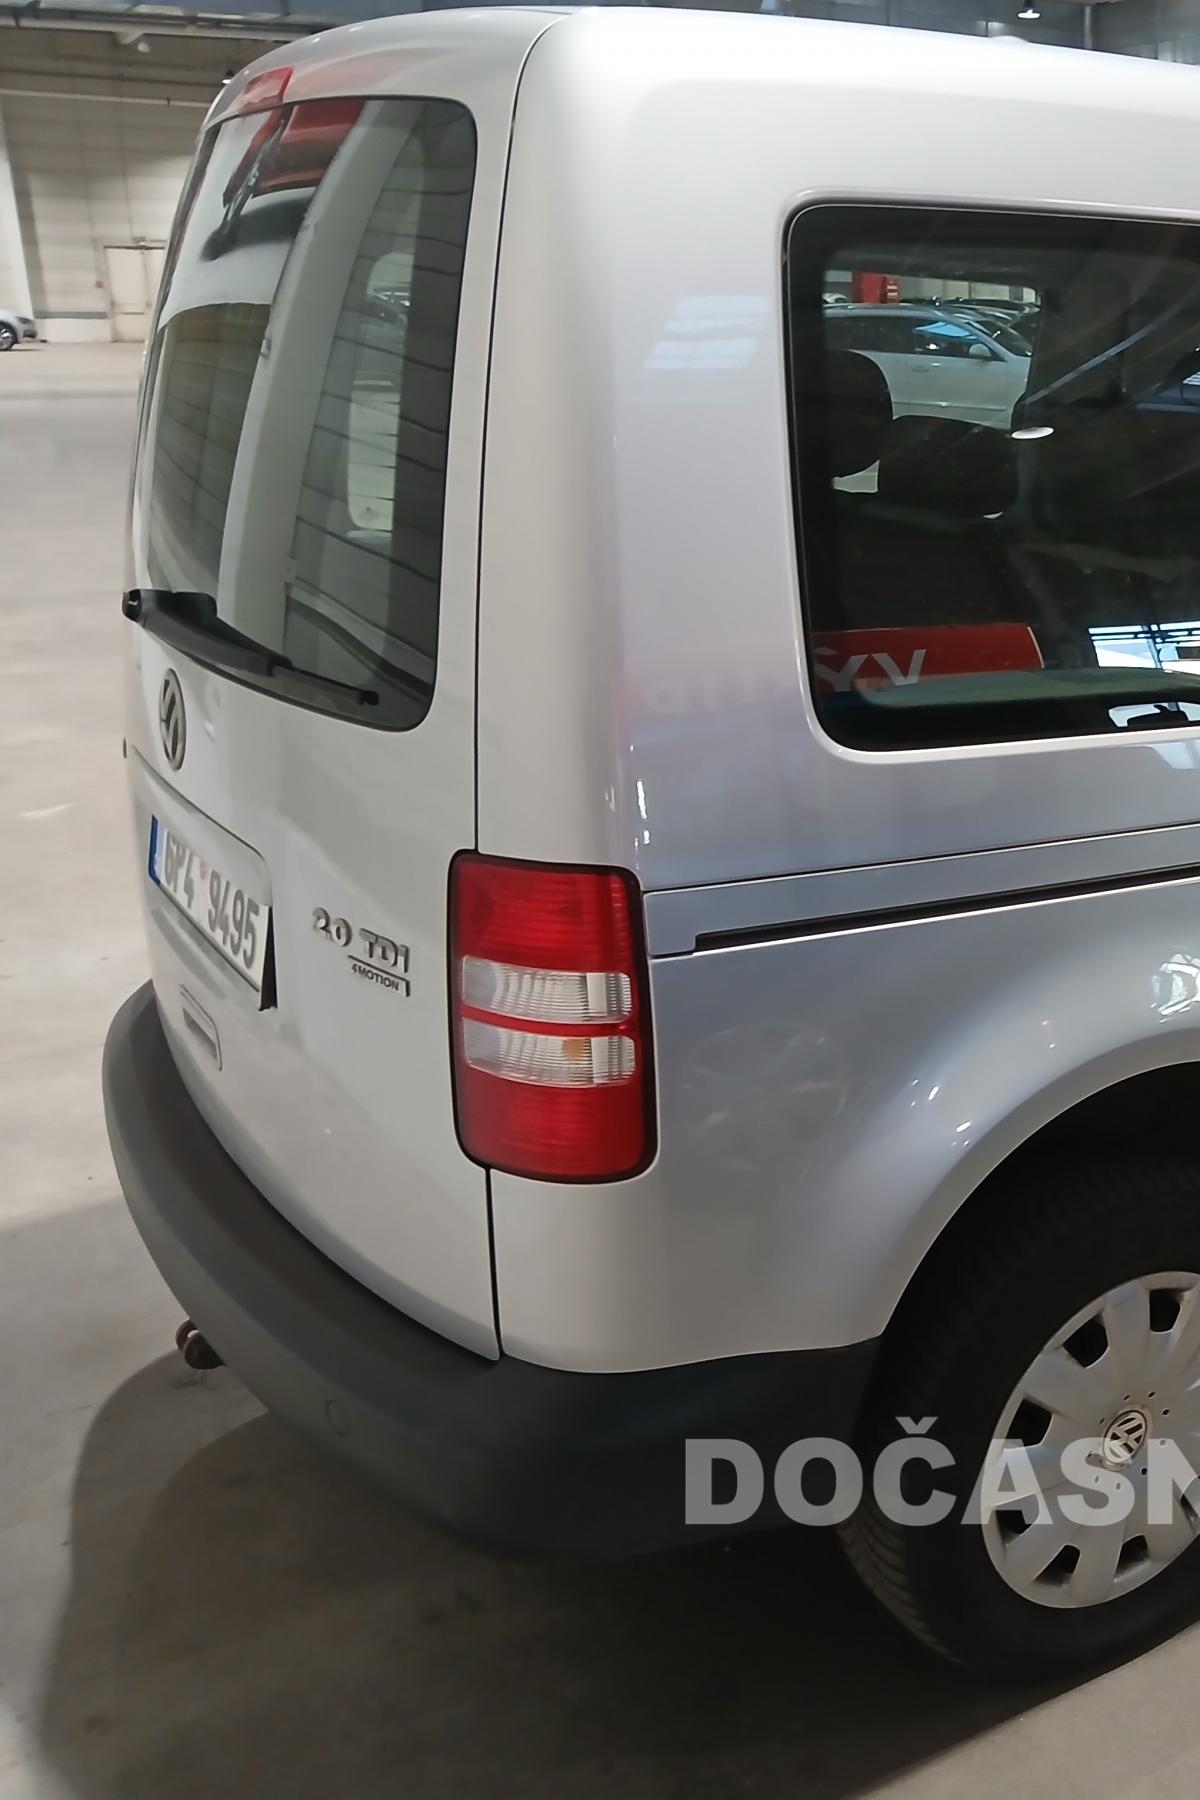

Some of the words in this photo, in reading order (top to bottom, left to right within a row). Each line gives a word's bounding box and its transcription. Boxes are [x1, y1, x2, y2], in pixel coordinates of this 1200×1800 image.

[208, 869, 260, 970] 9495
[359, 927, 409, 973] TDI
[351, 962, 400, 991] 4MOTION
